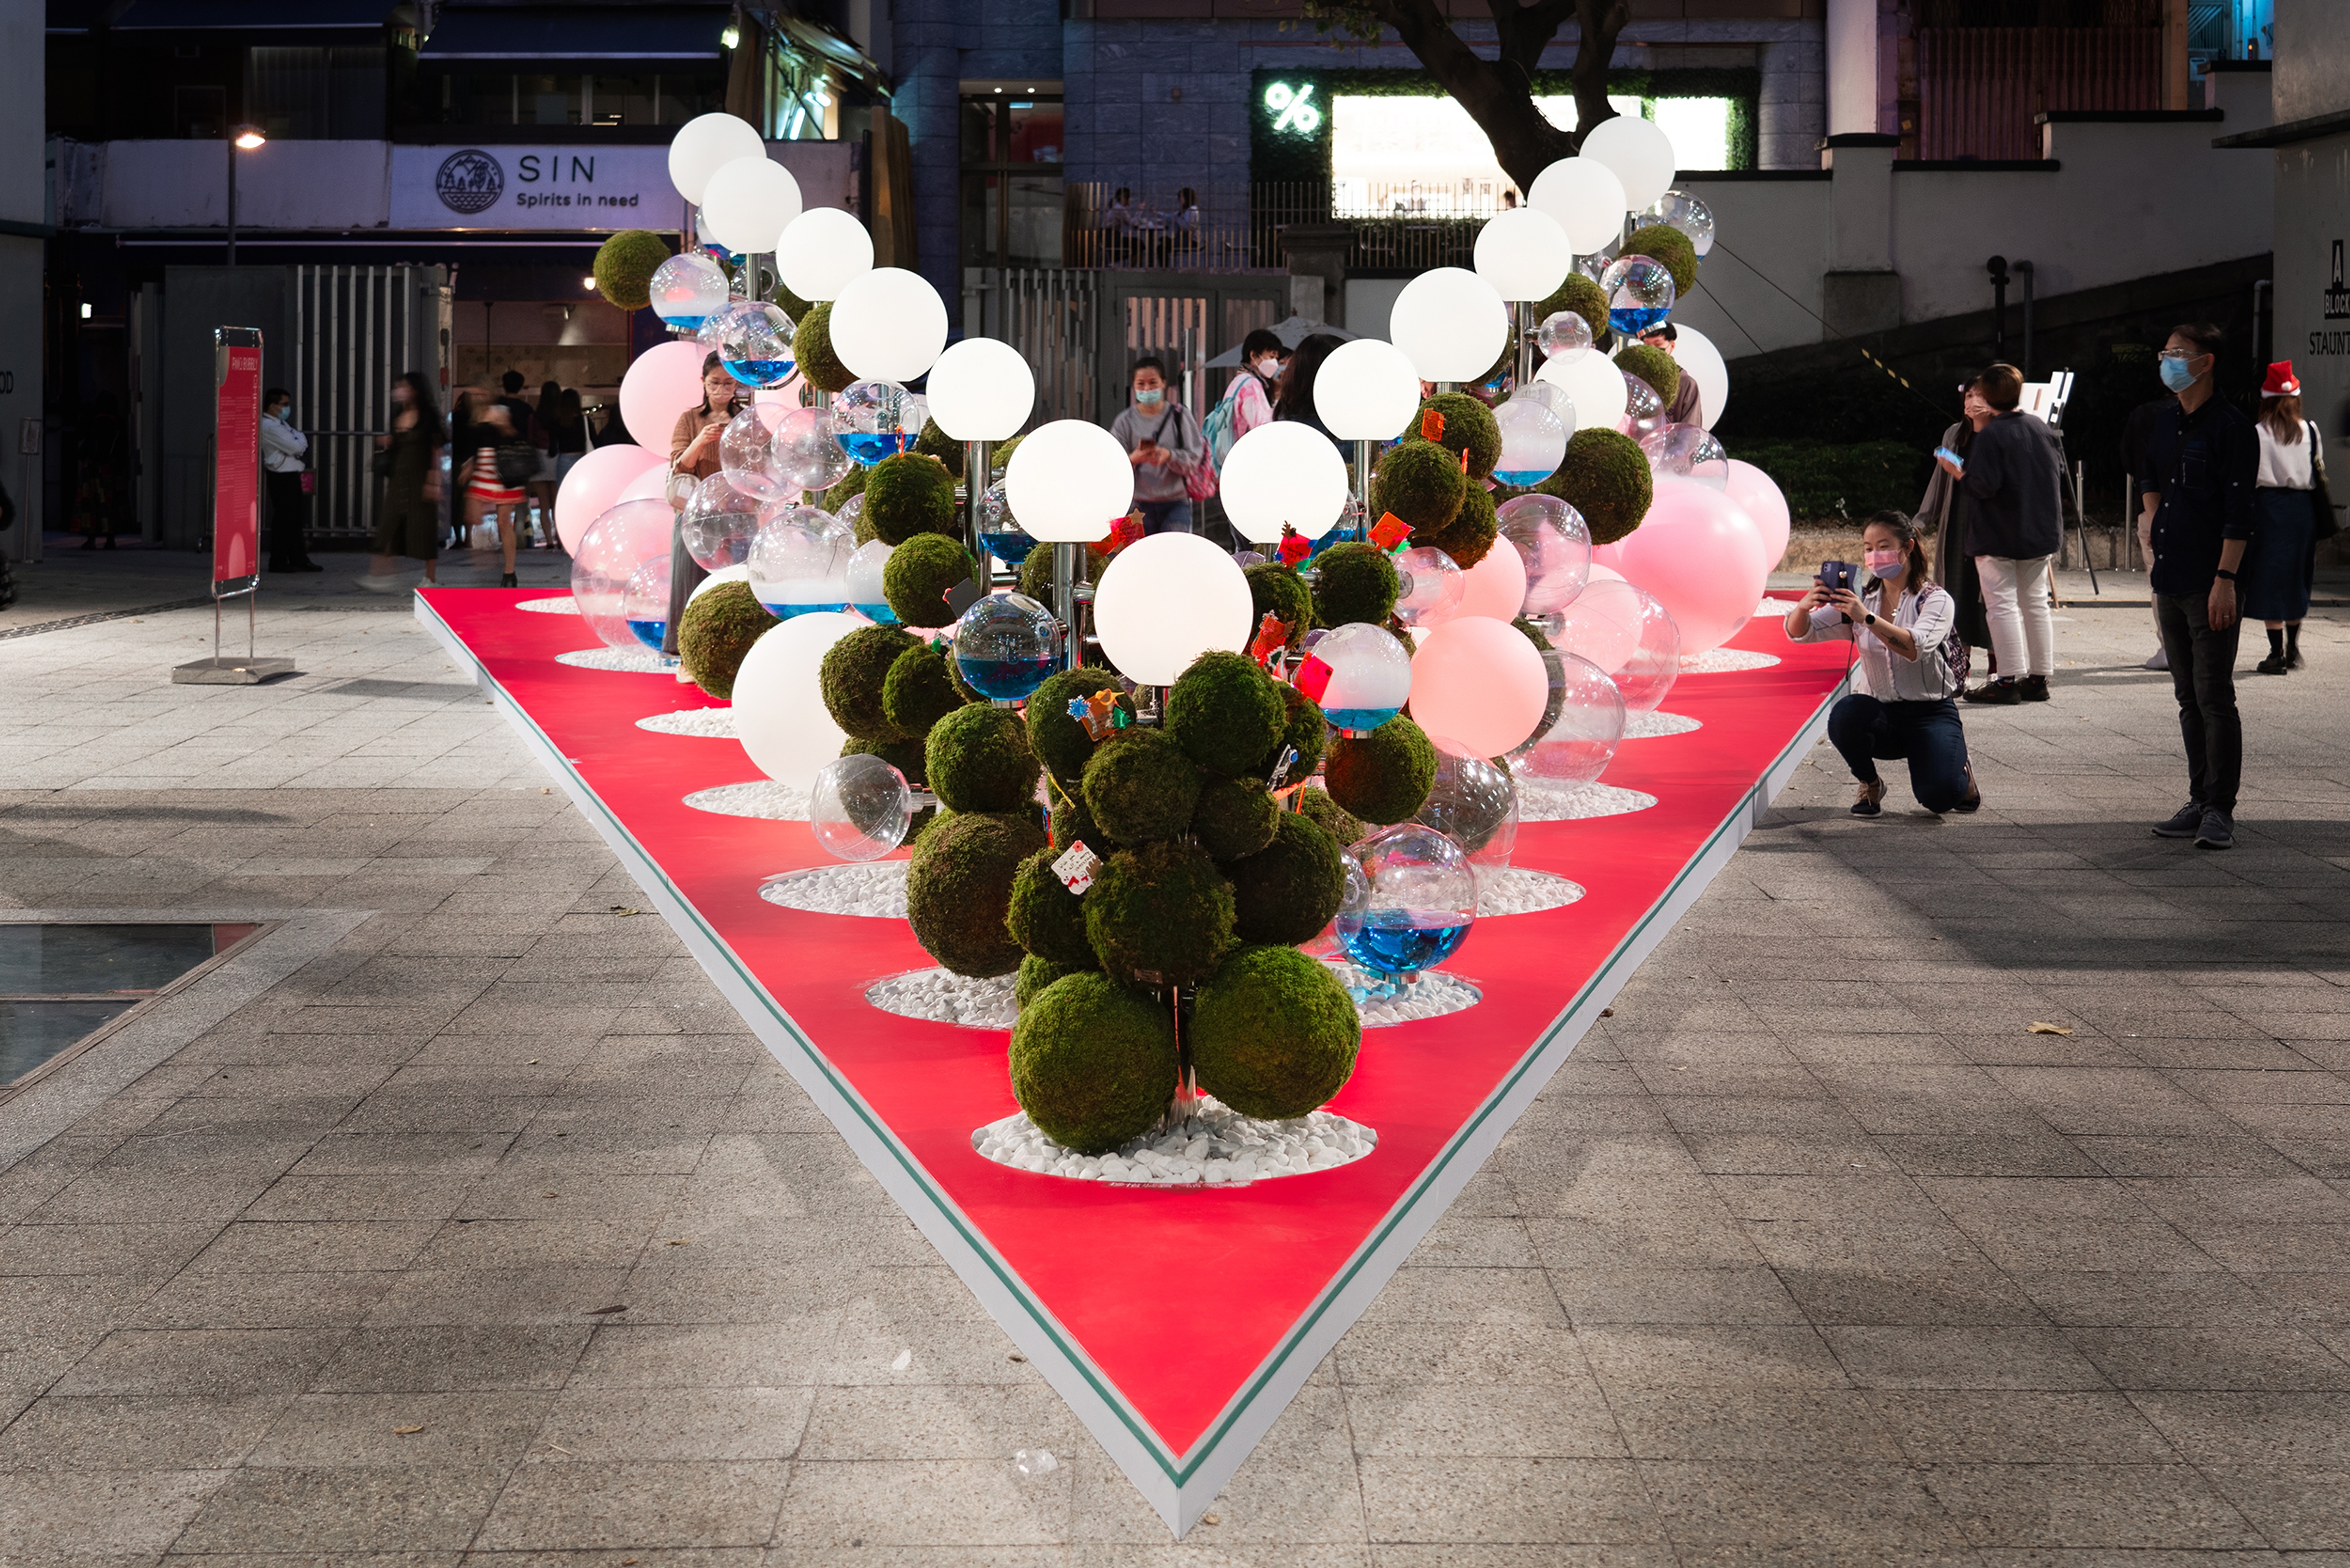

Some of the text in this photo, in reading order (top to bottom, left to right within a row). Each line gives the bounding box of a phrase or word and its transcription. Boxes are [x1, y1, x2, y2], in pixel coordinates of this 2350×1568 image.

[1265, 81, 1319, 132] %
[518, 155, 594, 182] SIN
[517, 193, 639, 208] Spirits in need
[2333, 245, 2343, 283] A
[2326, 294, 2350, 314] BLOCK
